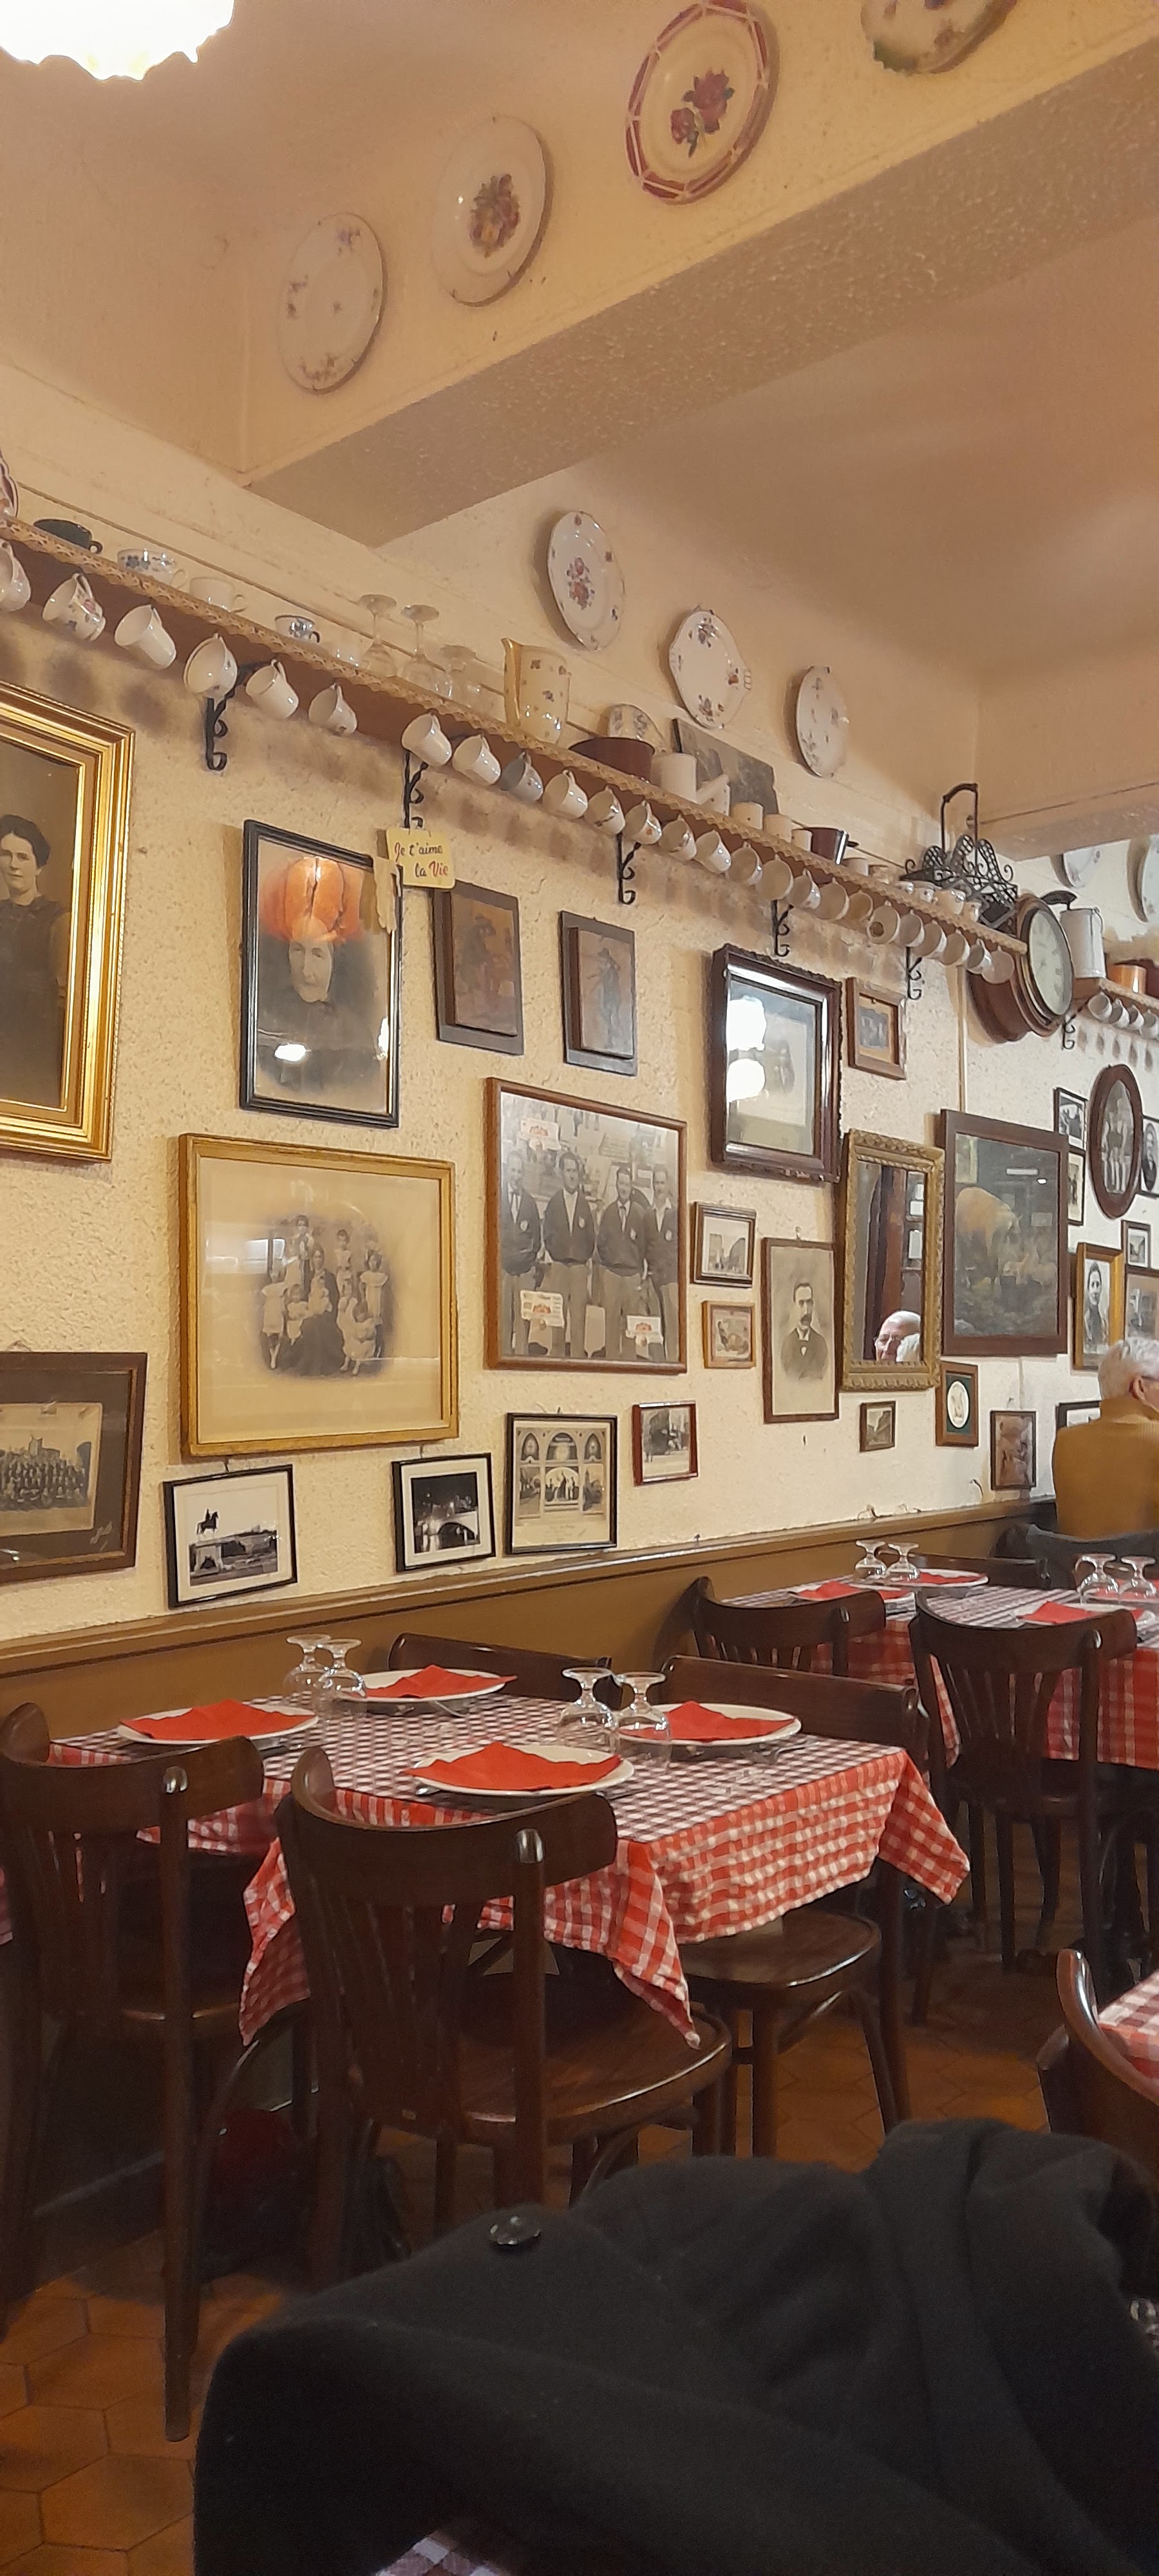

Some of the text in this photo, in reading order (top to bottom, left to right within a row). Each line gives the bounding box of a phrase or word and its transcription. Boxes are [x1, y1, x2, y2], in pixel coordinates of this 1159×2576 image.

[395, 842, 442, 862] Je t'aime
[415, 860, 449, 877] la Vie
